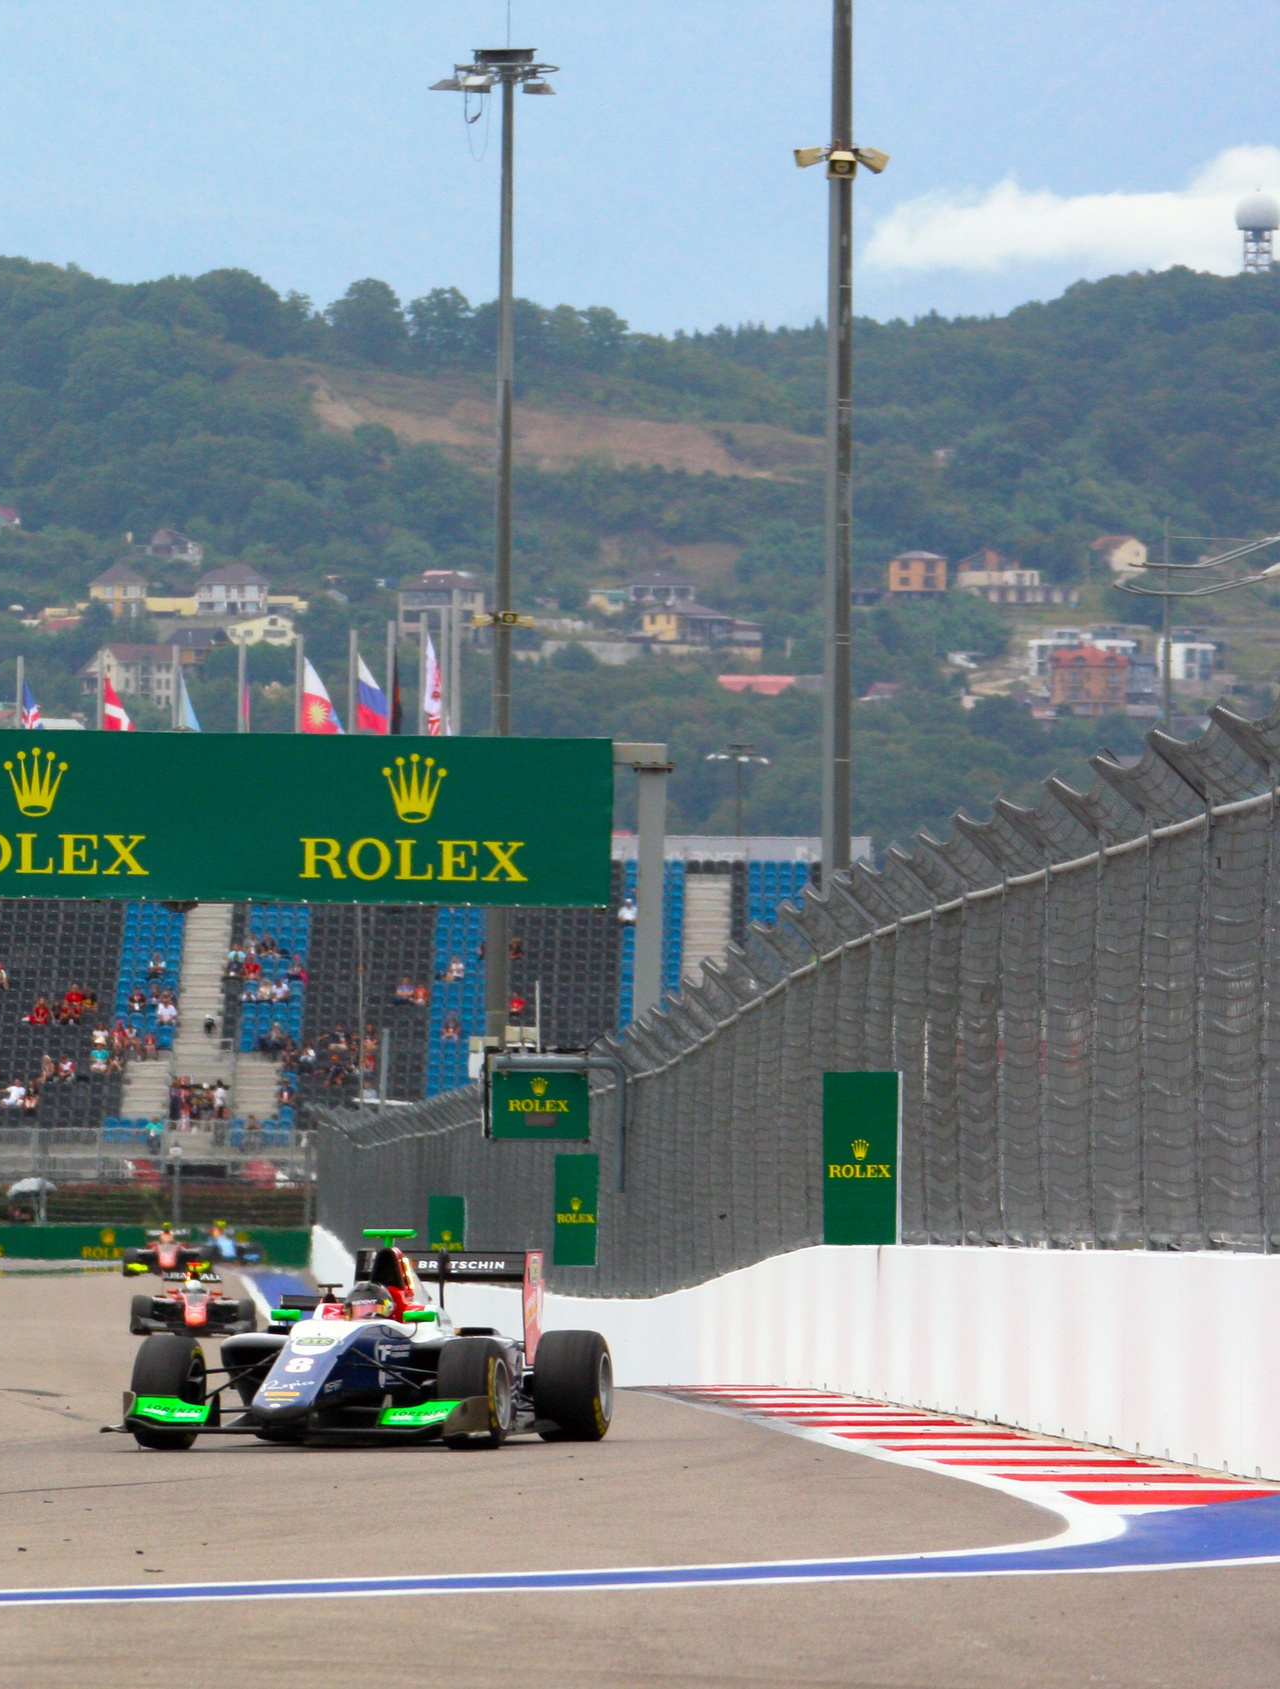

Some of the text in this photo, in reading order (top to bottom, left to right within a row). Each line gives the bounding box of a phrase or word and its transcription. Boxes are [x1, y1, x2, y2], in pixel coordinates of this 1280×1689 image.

[299, 837, 528, 882] ROLEX
[508, 1099, 569, 1112] ROLEX
[829, 1164, 891, 1178] ROLEX
[557, 1212, 595, 1224] ROLEX
[82, 1246, 124, 1258] ROLE
[418, 1260, 505, 1269] BRTSCHIN
[284, 1357, 315, 1373] 8
